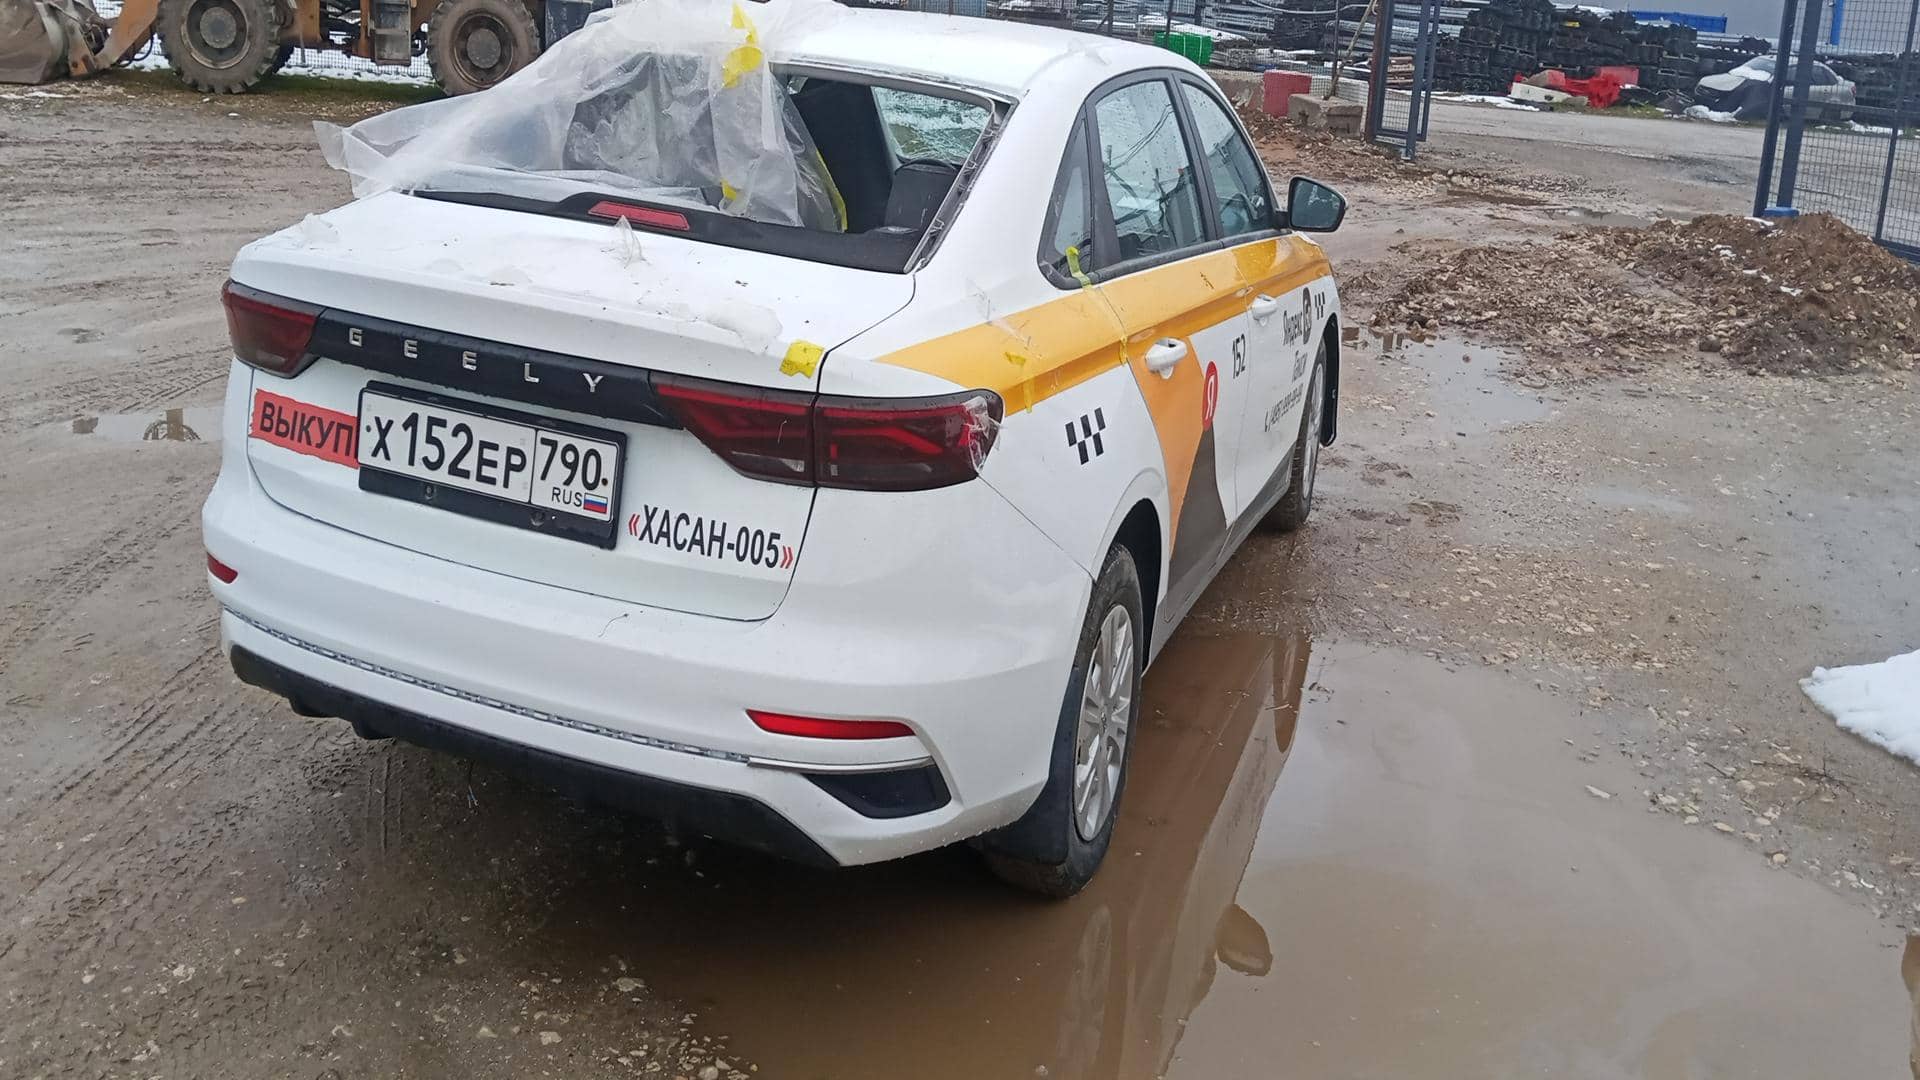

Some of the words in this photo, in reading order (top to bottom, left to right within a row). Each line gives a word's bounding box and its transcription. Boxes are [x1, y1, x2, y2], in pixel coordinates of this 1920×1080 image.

[349, 327, 604, 393] GEELY
[1231, 333, 1246, 380] 152
[259, 401, 354, 457] ВЫКУП
[539, 436, 604, 491] 790
[551, 486, 583, 509] RUS
